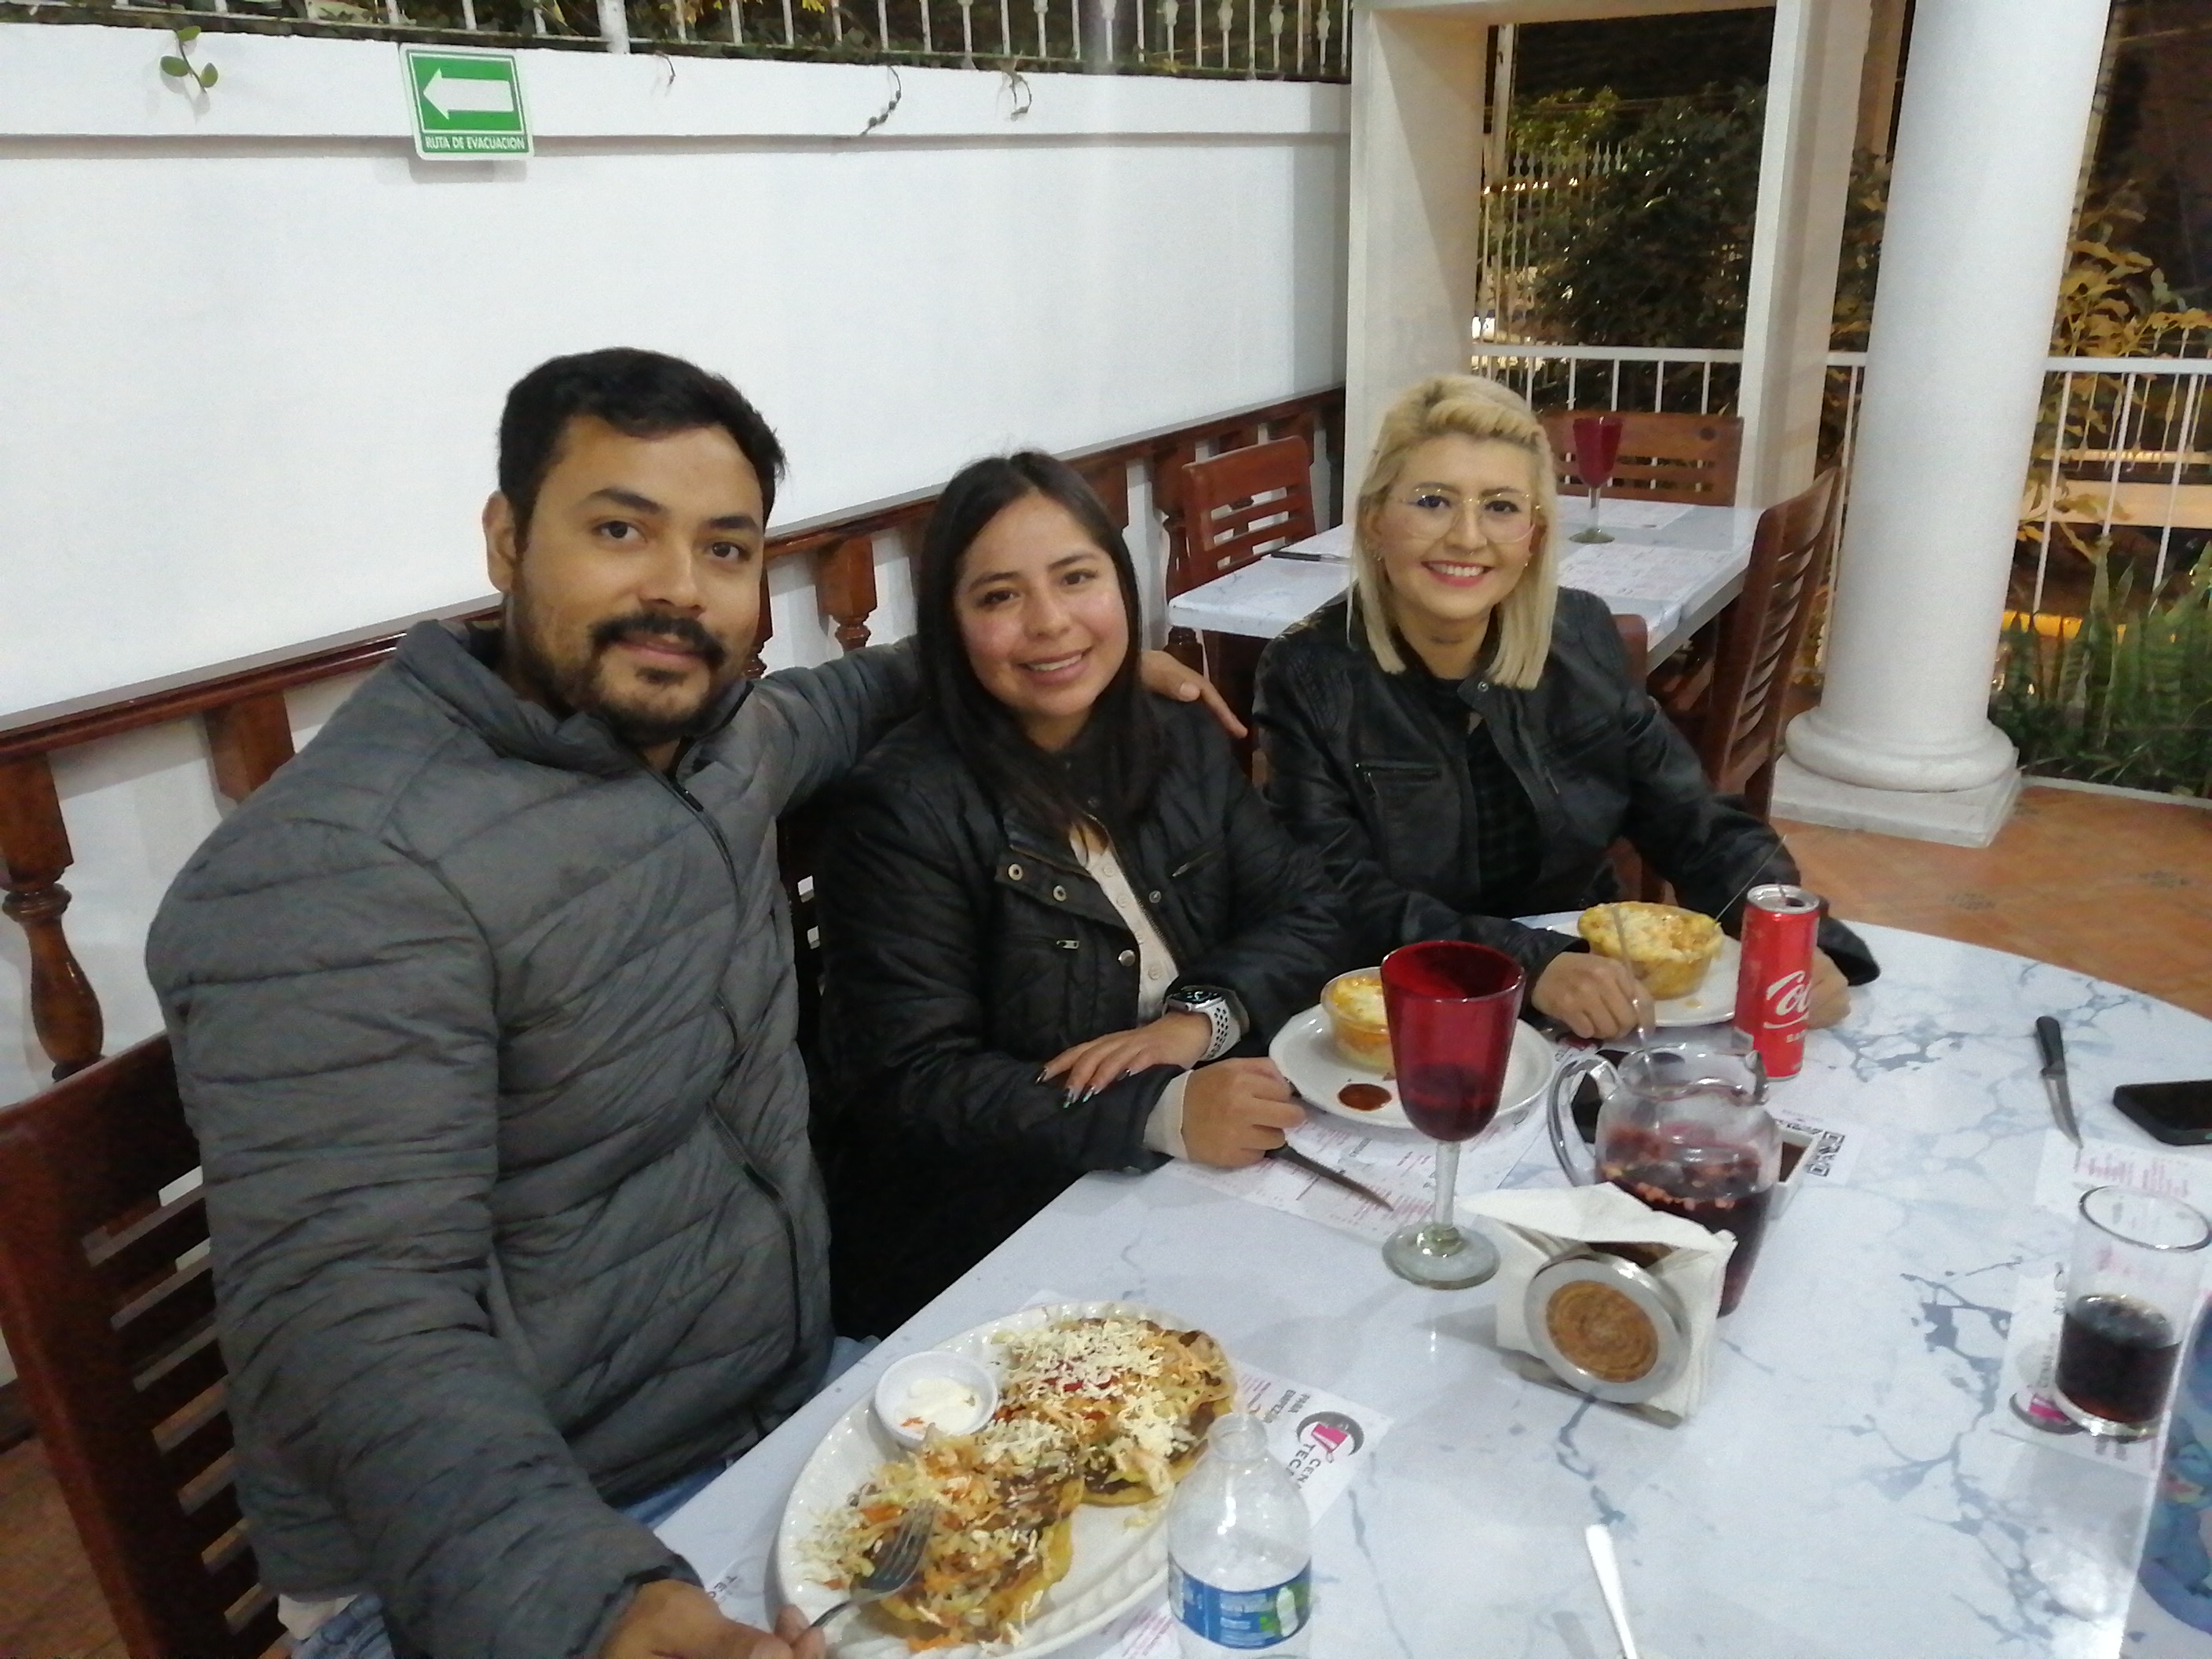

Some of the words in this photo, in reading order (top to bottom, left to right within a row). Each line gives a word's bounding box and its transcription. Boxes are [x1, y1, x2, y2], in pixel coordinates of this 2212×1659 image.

[425, 136, 451, 149] RUTA
[452, 136, 465, 149] DE
[466, 136, 526, 149] EVACUACION
